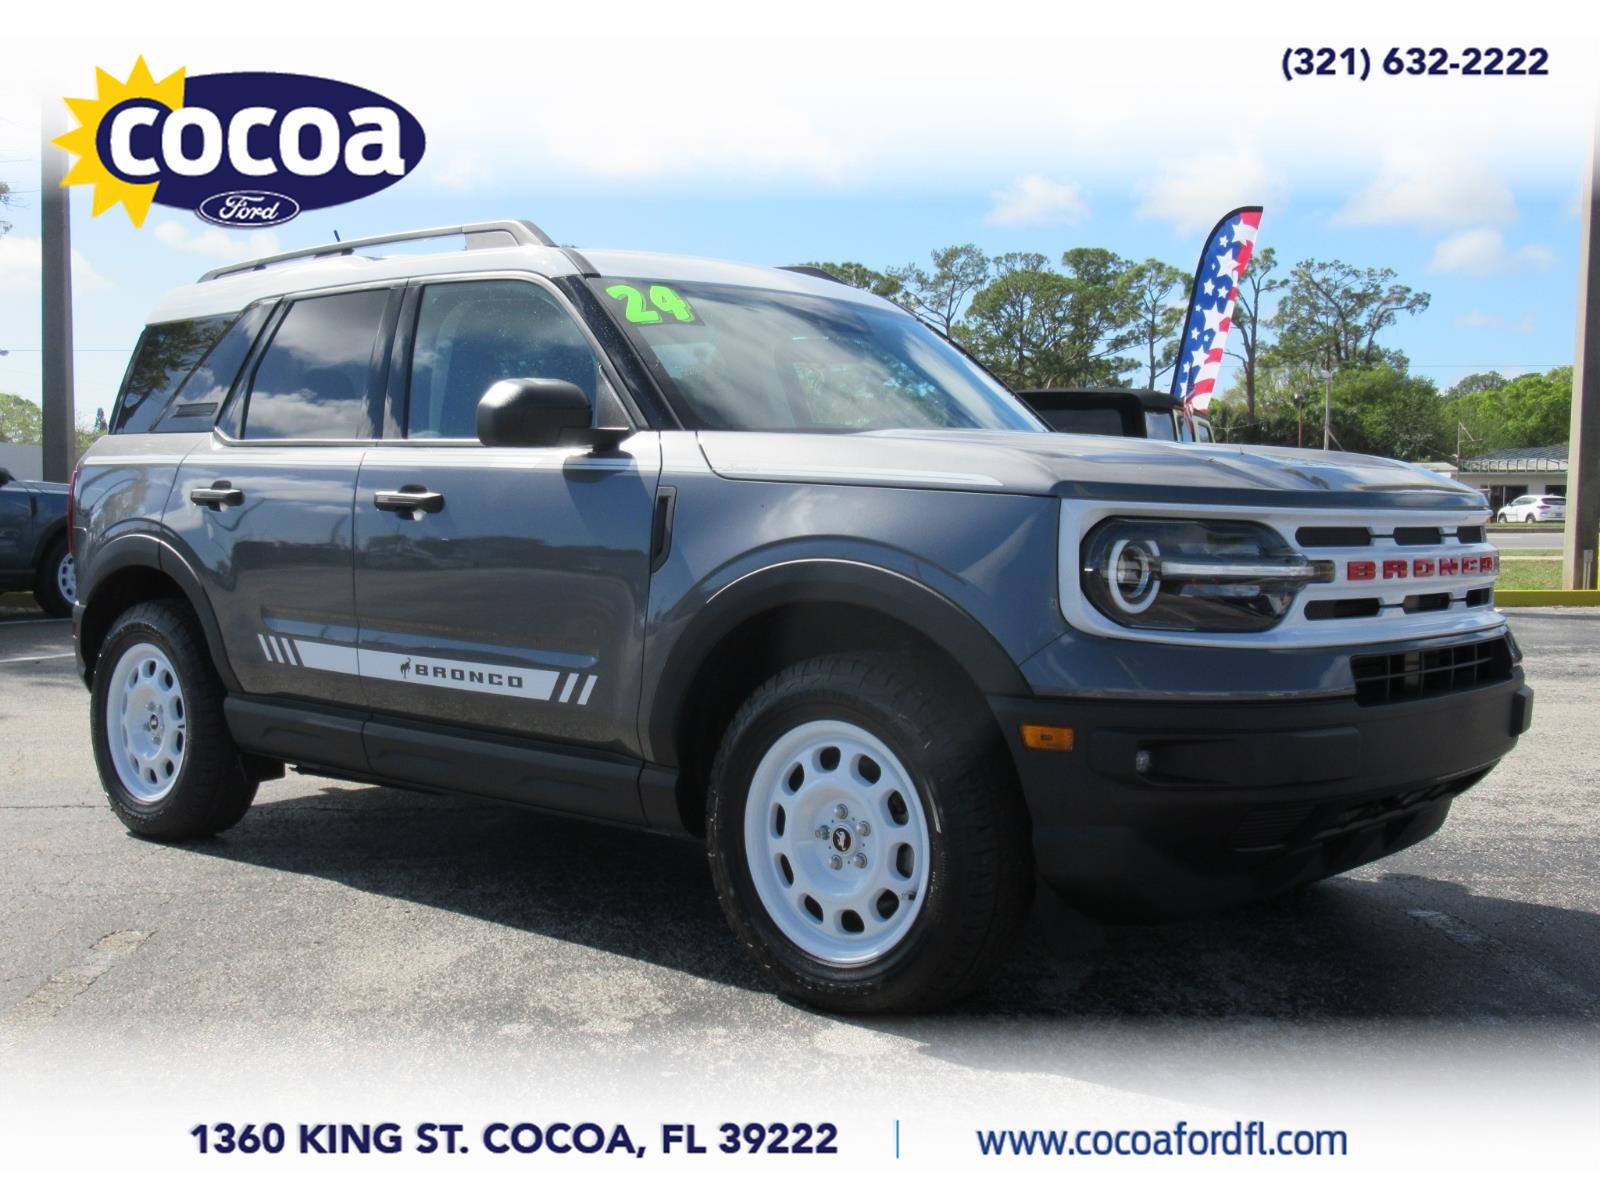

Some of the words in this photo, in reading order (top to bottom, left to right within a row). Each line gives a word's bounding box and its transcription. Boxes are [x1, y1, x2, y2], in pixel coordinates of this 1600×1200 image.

[605, 284, 695, 325] 24
[1347, 556, 1494, 581] BRONCO
[414, 663, 524, 689] BRONCO
